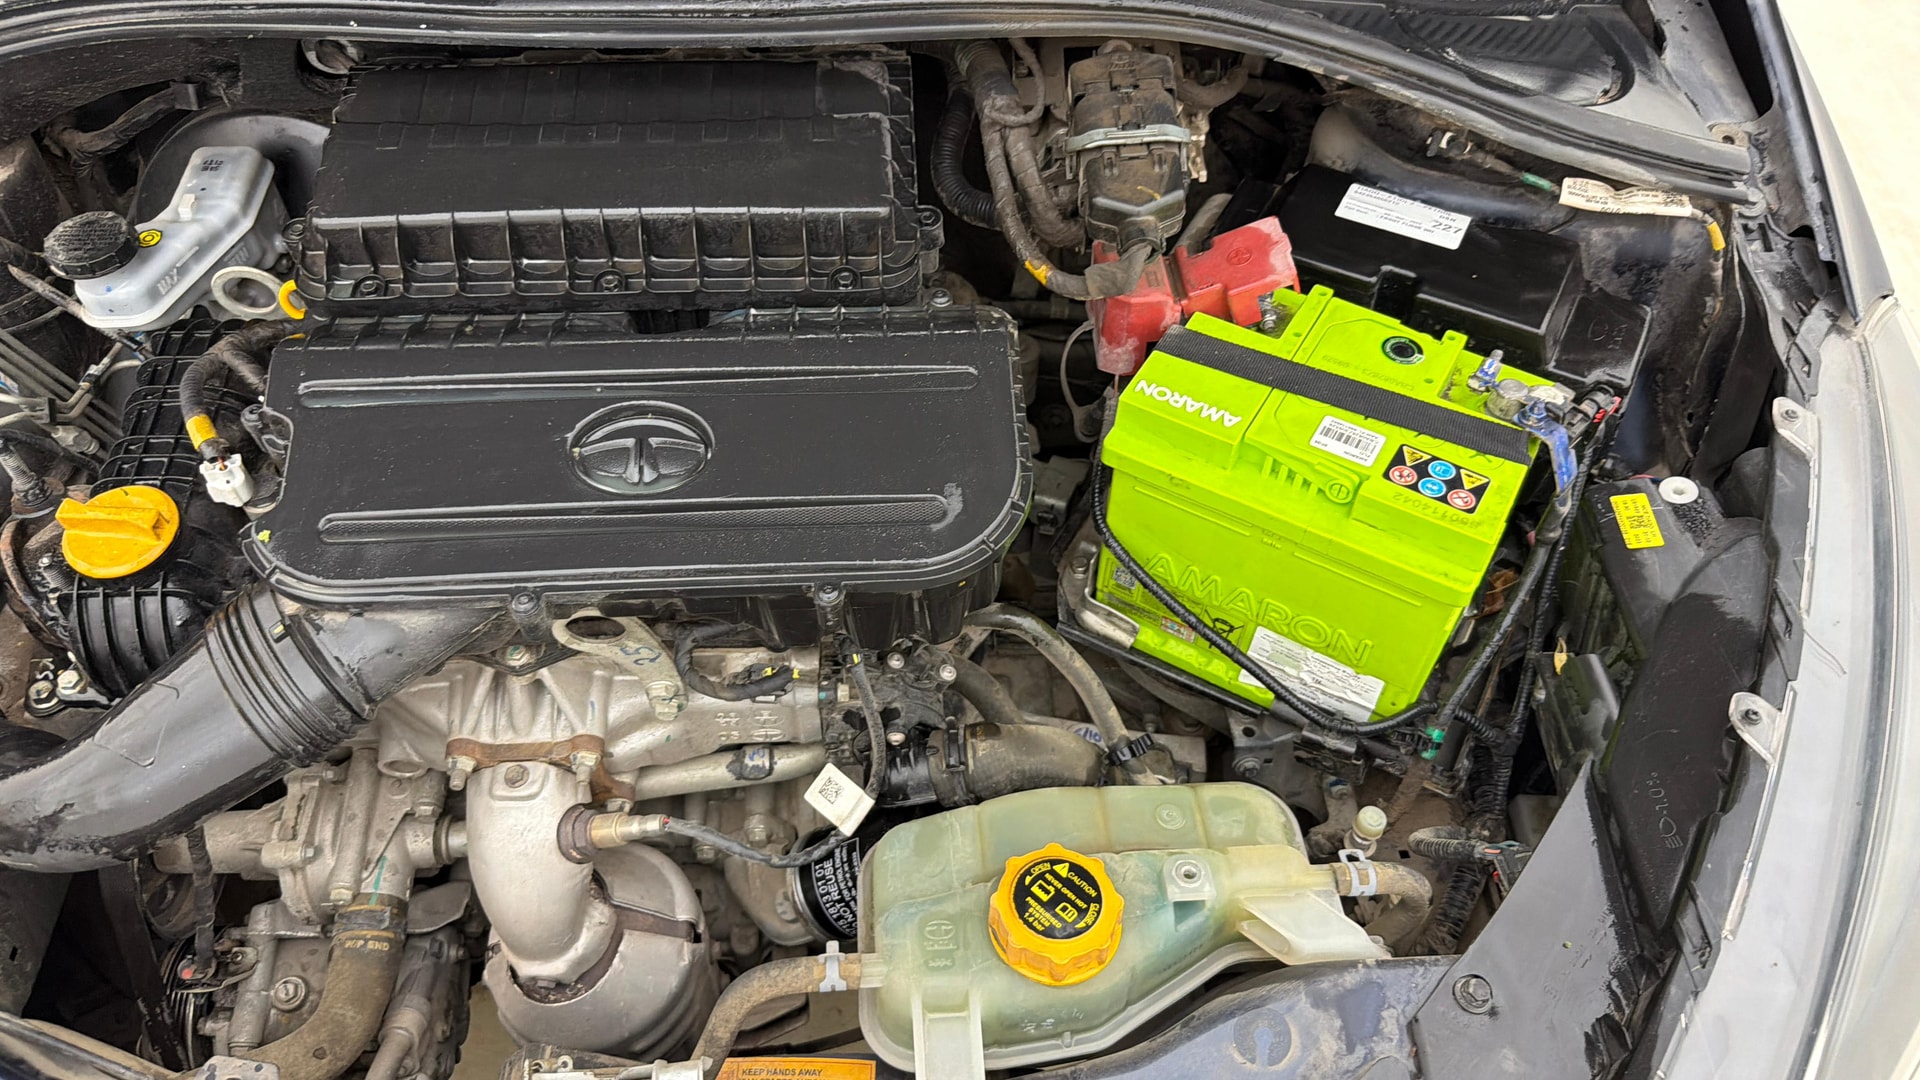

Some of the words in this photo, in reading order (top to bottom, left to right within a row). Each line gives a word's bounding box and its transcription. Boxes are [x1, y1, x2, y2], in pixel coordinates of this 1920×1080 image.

[1432, 218, 1463, 235] 227
[1134, 379, 1243, 428] AMARON
[1145, 553, 1372, 666] AMARON
[815, 863, 825, 878] 01
[1030, 862, 1051, 875] OPEN
[817, 879, 828, 894] 01
[823, 858, 842, 902] REUSE
[1067, 871, 1098, 898] CAUTION
[1044, 872, 1063, 890] NEVER
[1060, 886, 1077, 901] OPEN
[1074, 898, 1088, 910] HOT
[821, 894, 841, 919] 1813
[834, 902, 857, 923] NOT
[1025, 896, 1062, 929] PRESSURISED
[1086, 902, 1100, 926] CLOSE
[1028, 907, 1051, 928] SYSTEM
[1032, 920, 1046, 932] bar
[367, 940, 390, 951] END
[741, 1068, 765, 1077] KEEP
[767, 1068, 797, 1077] HANDS
[797, 1068, 823, 1077] AWAY
